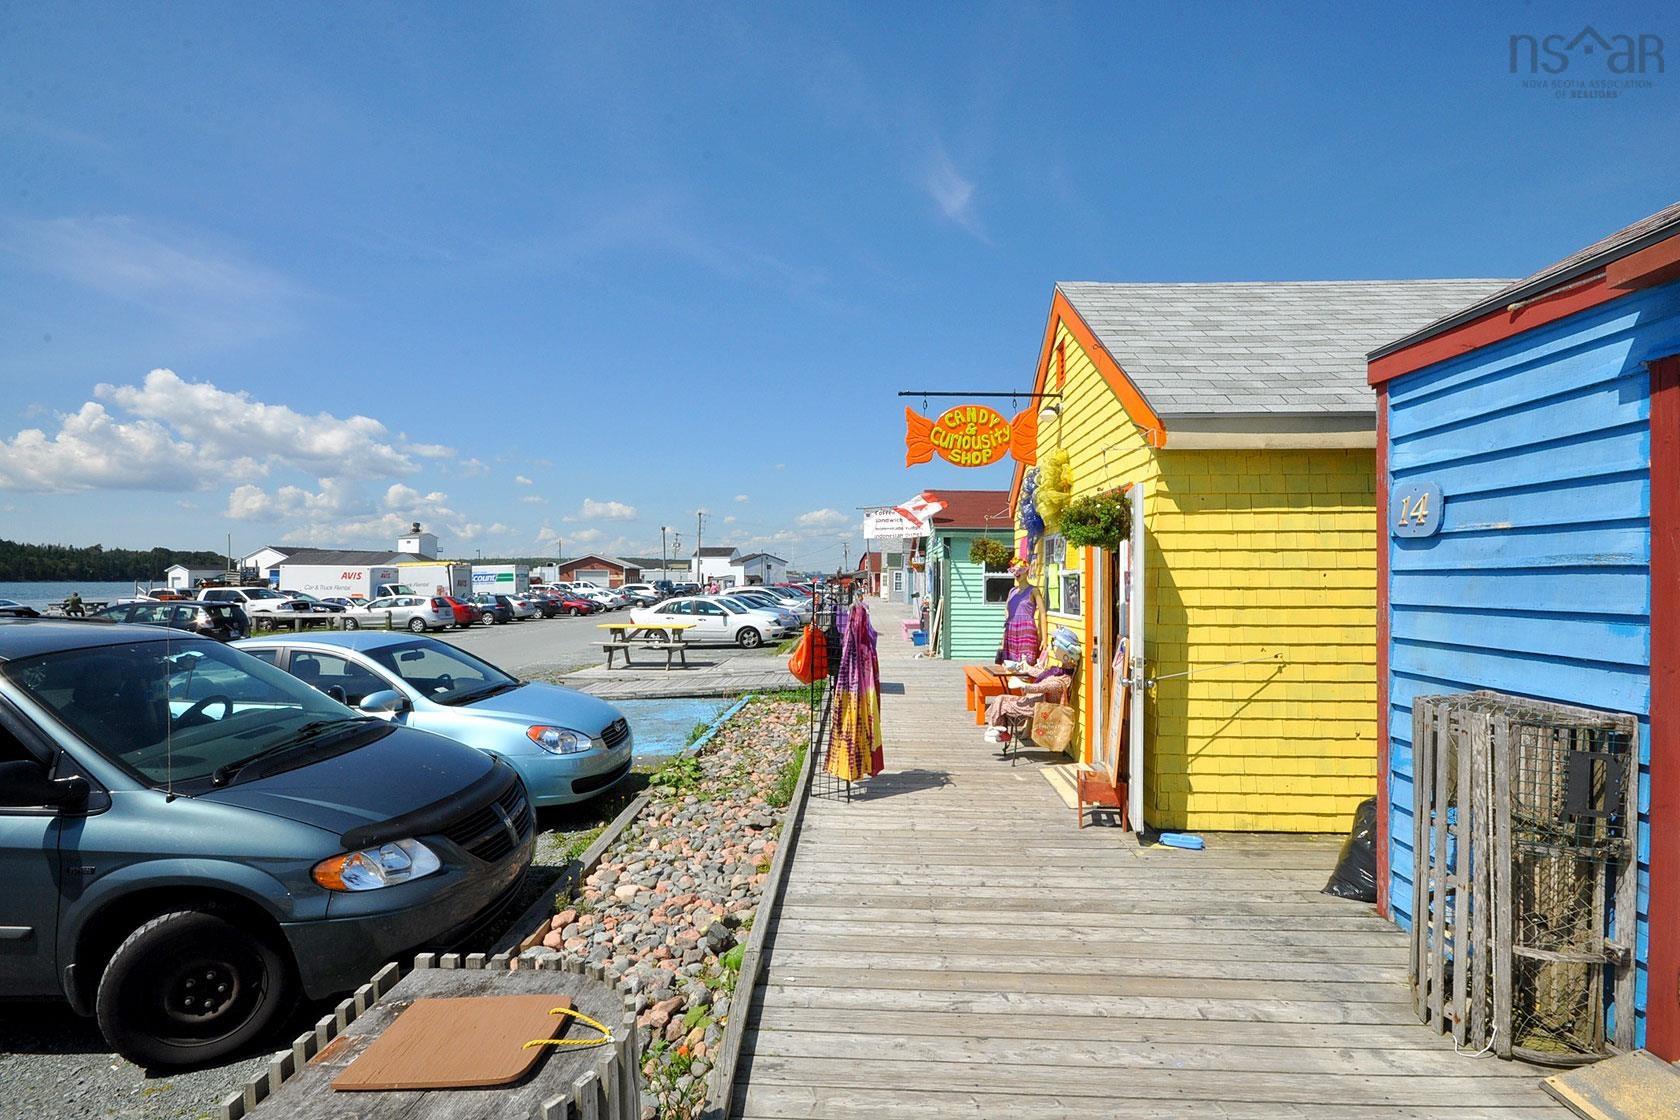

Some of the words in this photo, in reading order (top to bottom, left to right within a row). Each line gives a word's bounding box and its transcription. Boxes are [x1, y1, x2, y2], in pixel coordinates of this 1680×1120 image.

[945, 407, 999, 427] CANDY
[965, 422, 977, 436] &
[948, 449, 992, 465] SHOP
[1398, 492, 1429, 527] 14
[341, 571, 362, 580] AVIS
